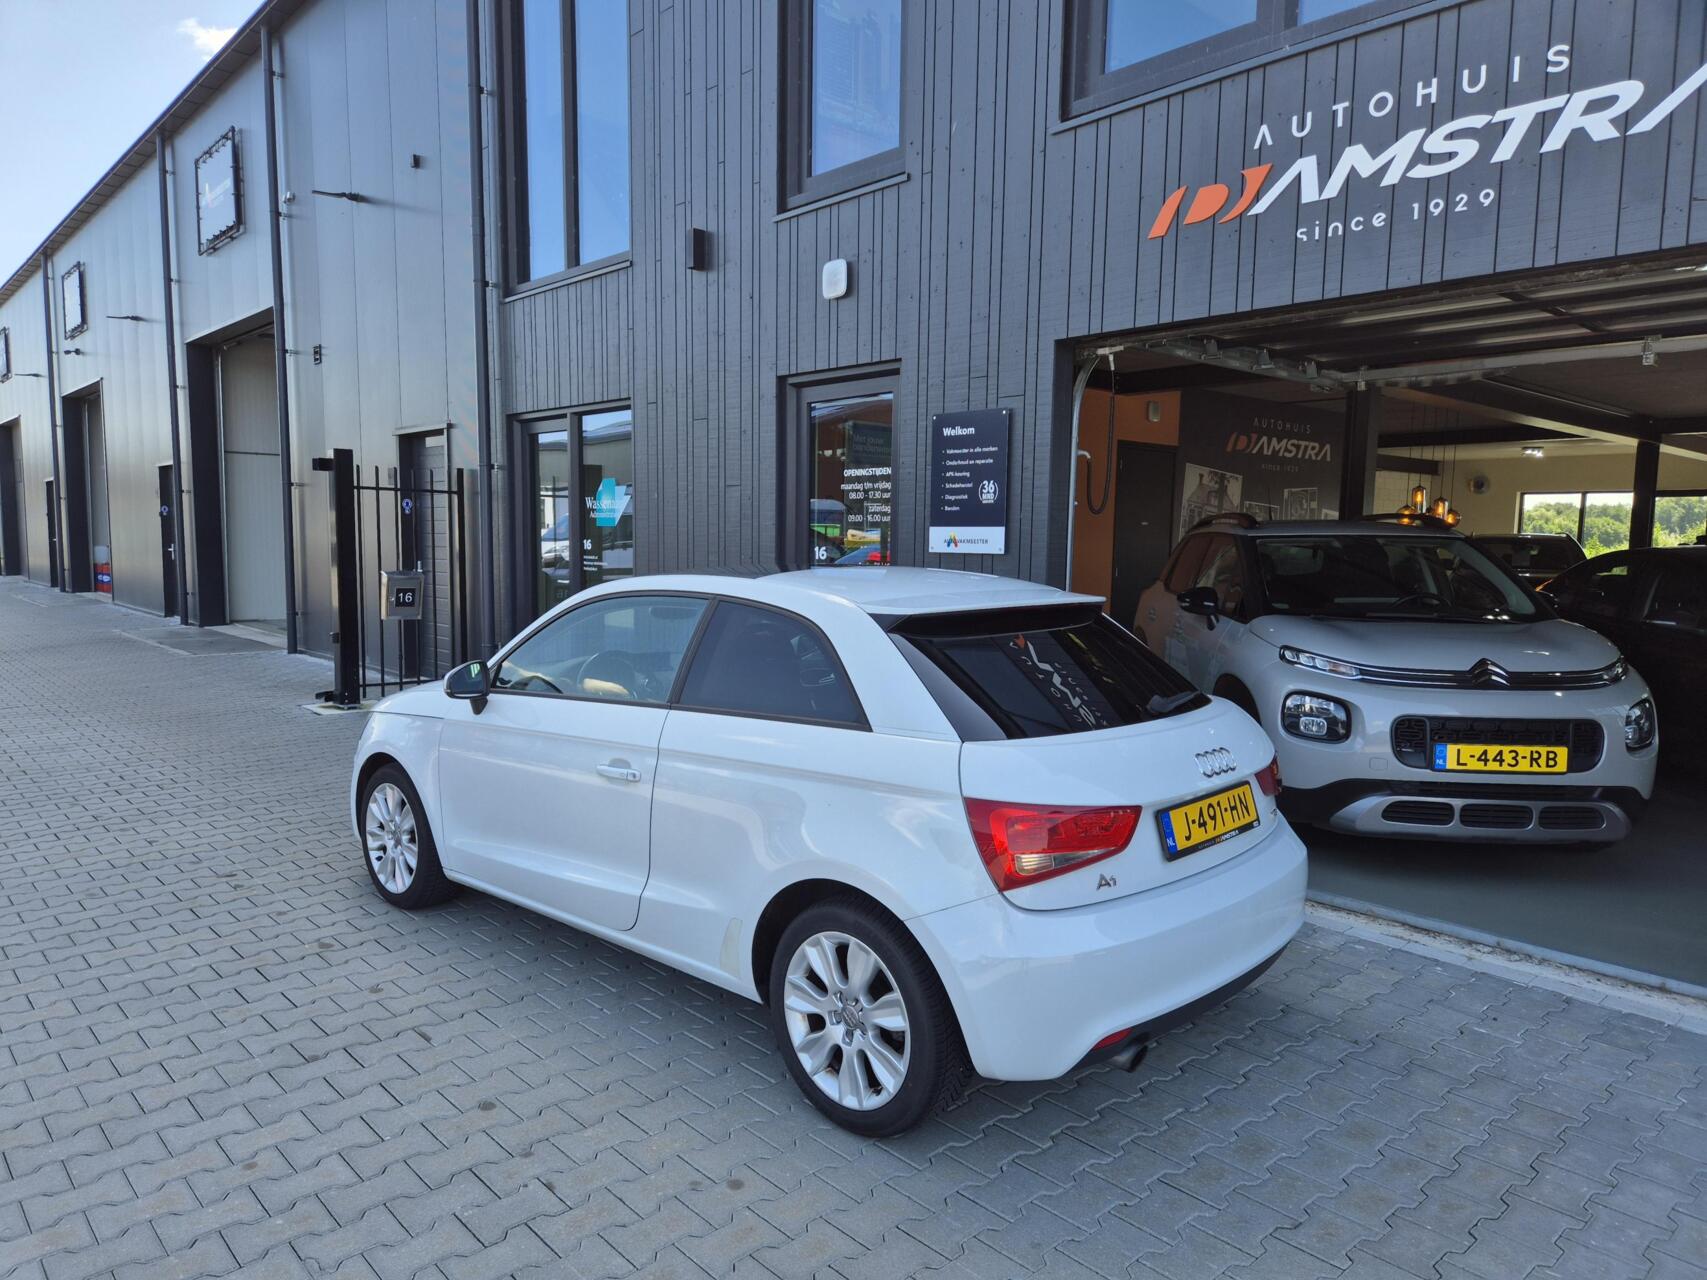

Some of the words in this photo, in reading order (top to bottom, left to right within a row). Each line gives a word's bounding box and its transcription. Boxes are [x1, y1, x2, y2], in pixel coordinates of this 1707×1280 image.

[1254, 45, 1570, 149] AUTOHUIS
[1297, 212, 1386, 241] since
[1412, 189, 1495, 220] 1929
[943, 426, 975, 436] Welkom
[1253, 417, 1312, 434] AUTOHUIS
[1226, 432, 1331, 462] DAMSTRA
[844, 467, 891, 477] OPENINGSTIJDEN
[874, 481, 891, 490] vrijdag
[982, 480, 995, 493] 36
[868, 491, 880, 499] 17.30
[869, 504, 891, 513] zaterdag
[583, 539, 592, 550] 16
[814, 546, 827, 560] 16
[399, 592, 413, 602] 16
[1456, 748, 1558, 768] L-443-RB
[1167, 837, 1176, 847] NL
[1184, 791, 1251, 841] J-491-HN
[1096, 873, 1117, 890] A1
